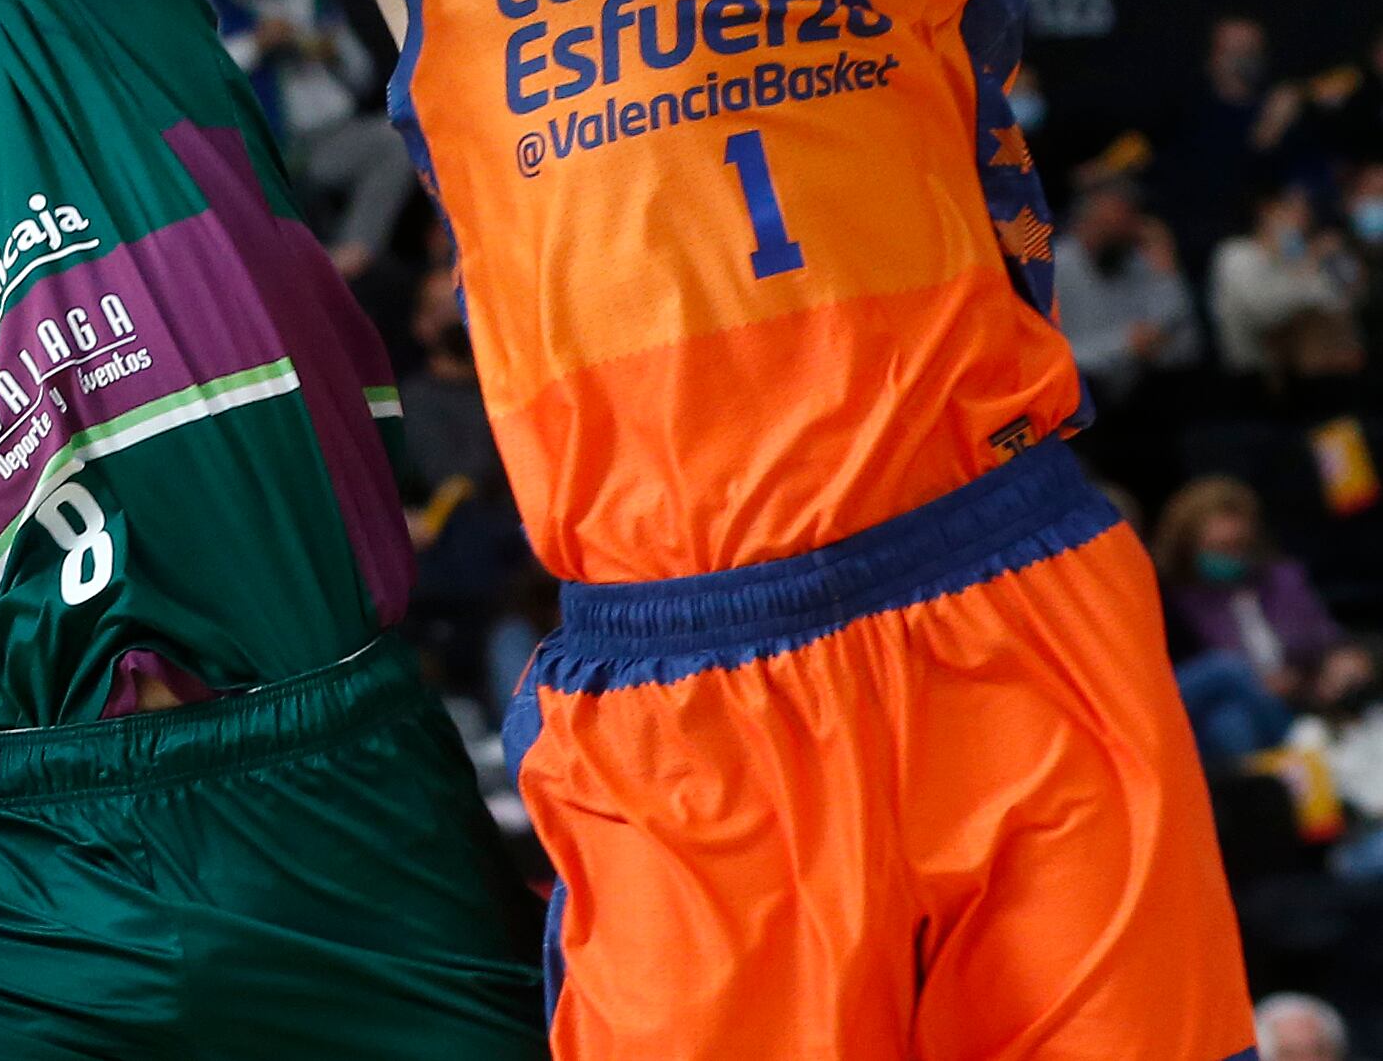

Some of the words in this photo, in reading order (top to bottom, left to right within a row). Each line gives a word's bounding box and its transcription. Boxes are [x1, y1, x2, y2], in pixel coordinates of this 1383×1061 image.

[517, 52, 900, 178] @ValenciaBasket
[724, 129, 805, 280] 1
[49, 387, 67, 414] y
[36, 482, 114, 607] 8
